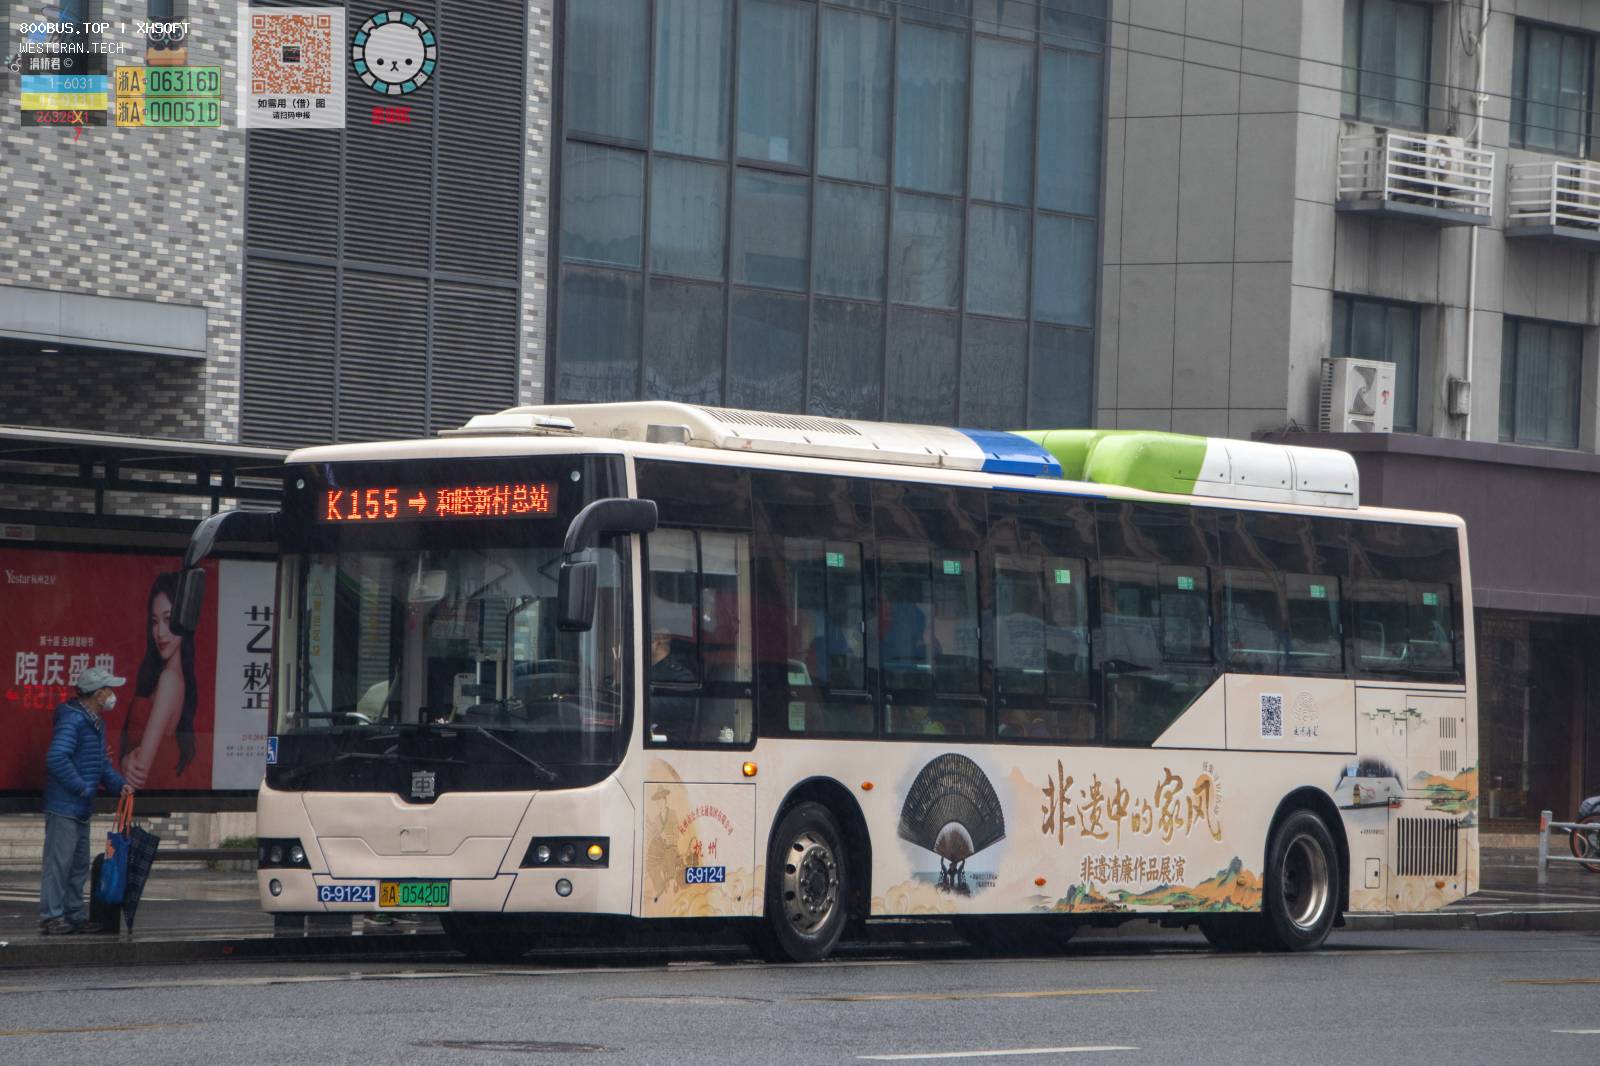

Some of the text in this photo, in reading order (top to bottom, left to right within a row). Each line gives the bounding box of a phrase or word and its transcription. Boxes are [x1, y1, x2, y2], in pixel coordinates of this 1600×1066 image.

[326, 484, 549, 520] K155 和睦新村总站
[686, 867, 723, 883] 6-9124
[1080, 855, 1186, 883] 非遗清廉作品展演
[320, 886, 372, 902] 6-9124
